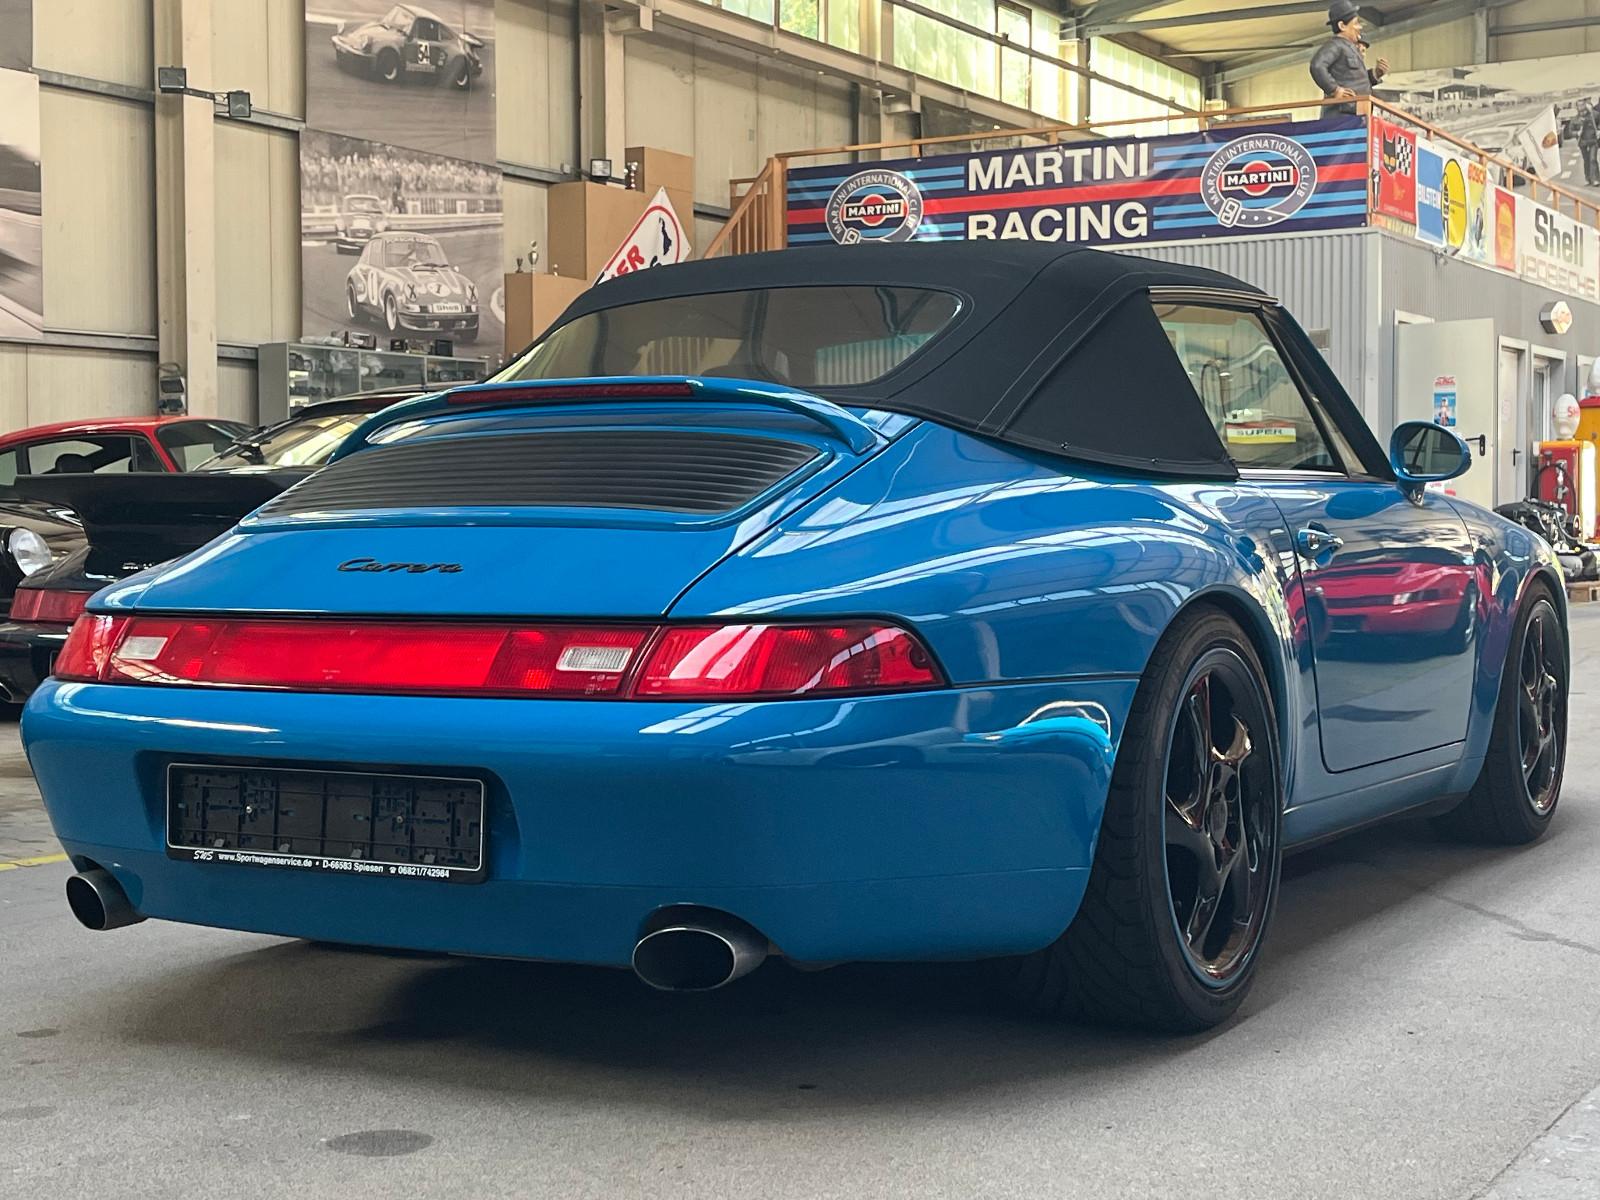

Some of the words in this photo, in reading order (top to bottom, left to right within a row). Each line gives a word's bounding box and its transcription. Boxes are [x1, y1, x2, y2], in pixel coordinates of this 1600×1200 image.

[968, 143, 1149, 191] MARTINI
[1207, 156, 1226, 205] MARTINI
[1227, 139, 1303, 165] INTERNATIONAL
[1296, 165, 1310, 198] CLUB
[1227, 170, 1288, 186] MARTINI
[831, 189, 849, 234] MARTINI
[847, 174, 911, 199] INTERNATIONAL
[848, 203, 900, 217] MARTINI
[968, 201, 1148, 242] RACING
[1534, 207, 1584, 267] Shell
[337, 556, 464, 574] Carrera
[218, 852, 312, 867] www.Sportwagenservice.de
[353, 862, 384, 873] Spiesen
